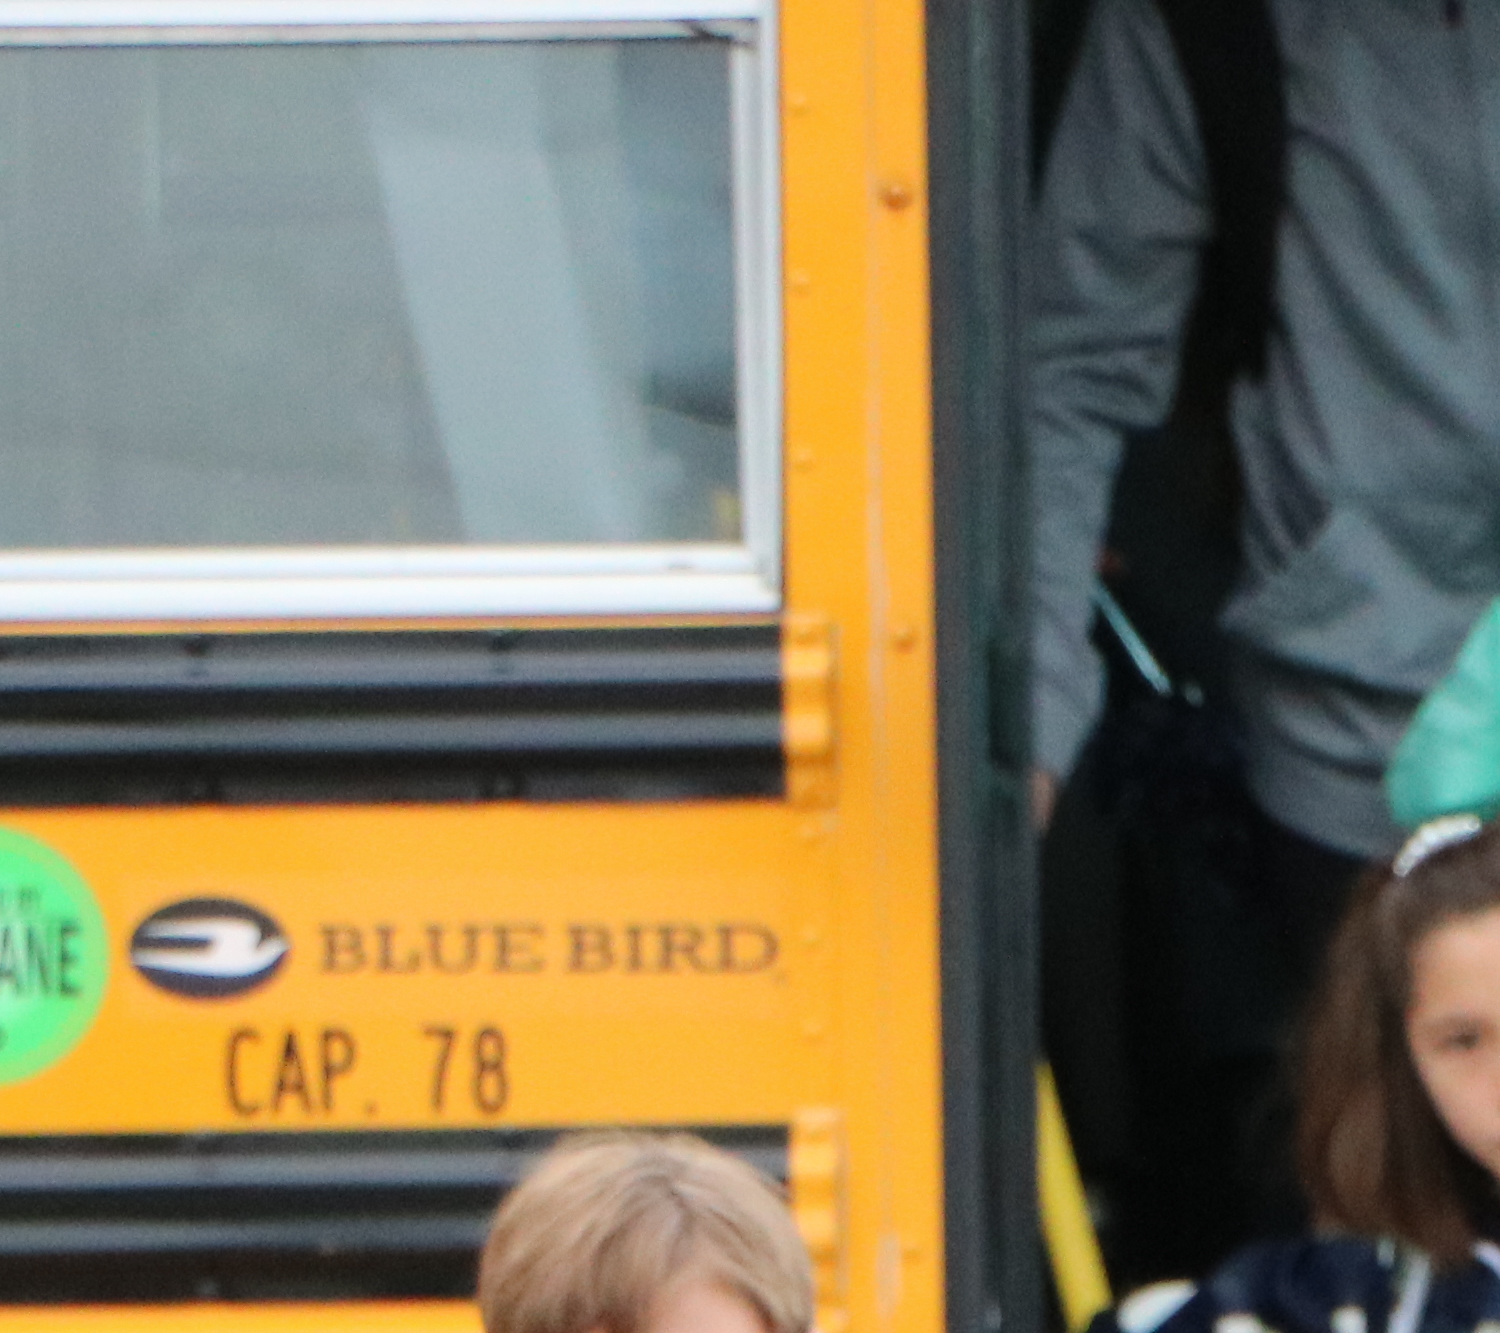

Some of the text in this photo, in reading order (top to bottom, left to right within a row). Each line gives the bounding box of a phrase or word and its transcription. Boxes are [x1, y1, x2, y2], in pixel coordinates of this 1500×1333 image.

[320, 922, 779, 975] BLUE BIRD
[223, 1025, 511, 1116] CAP. 78
